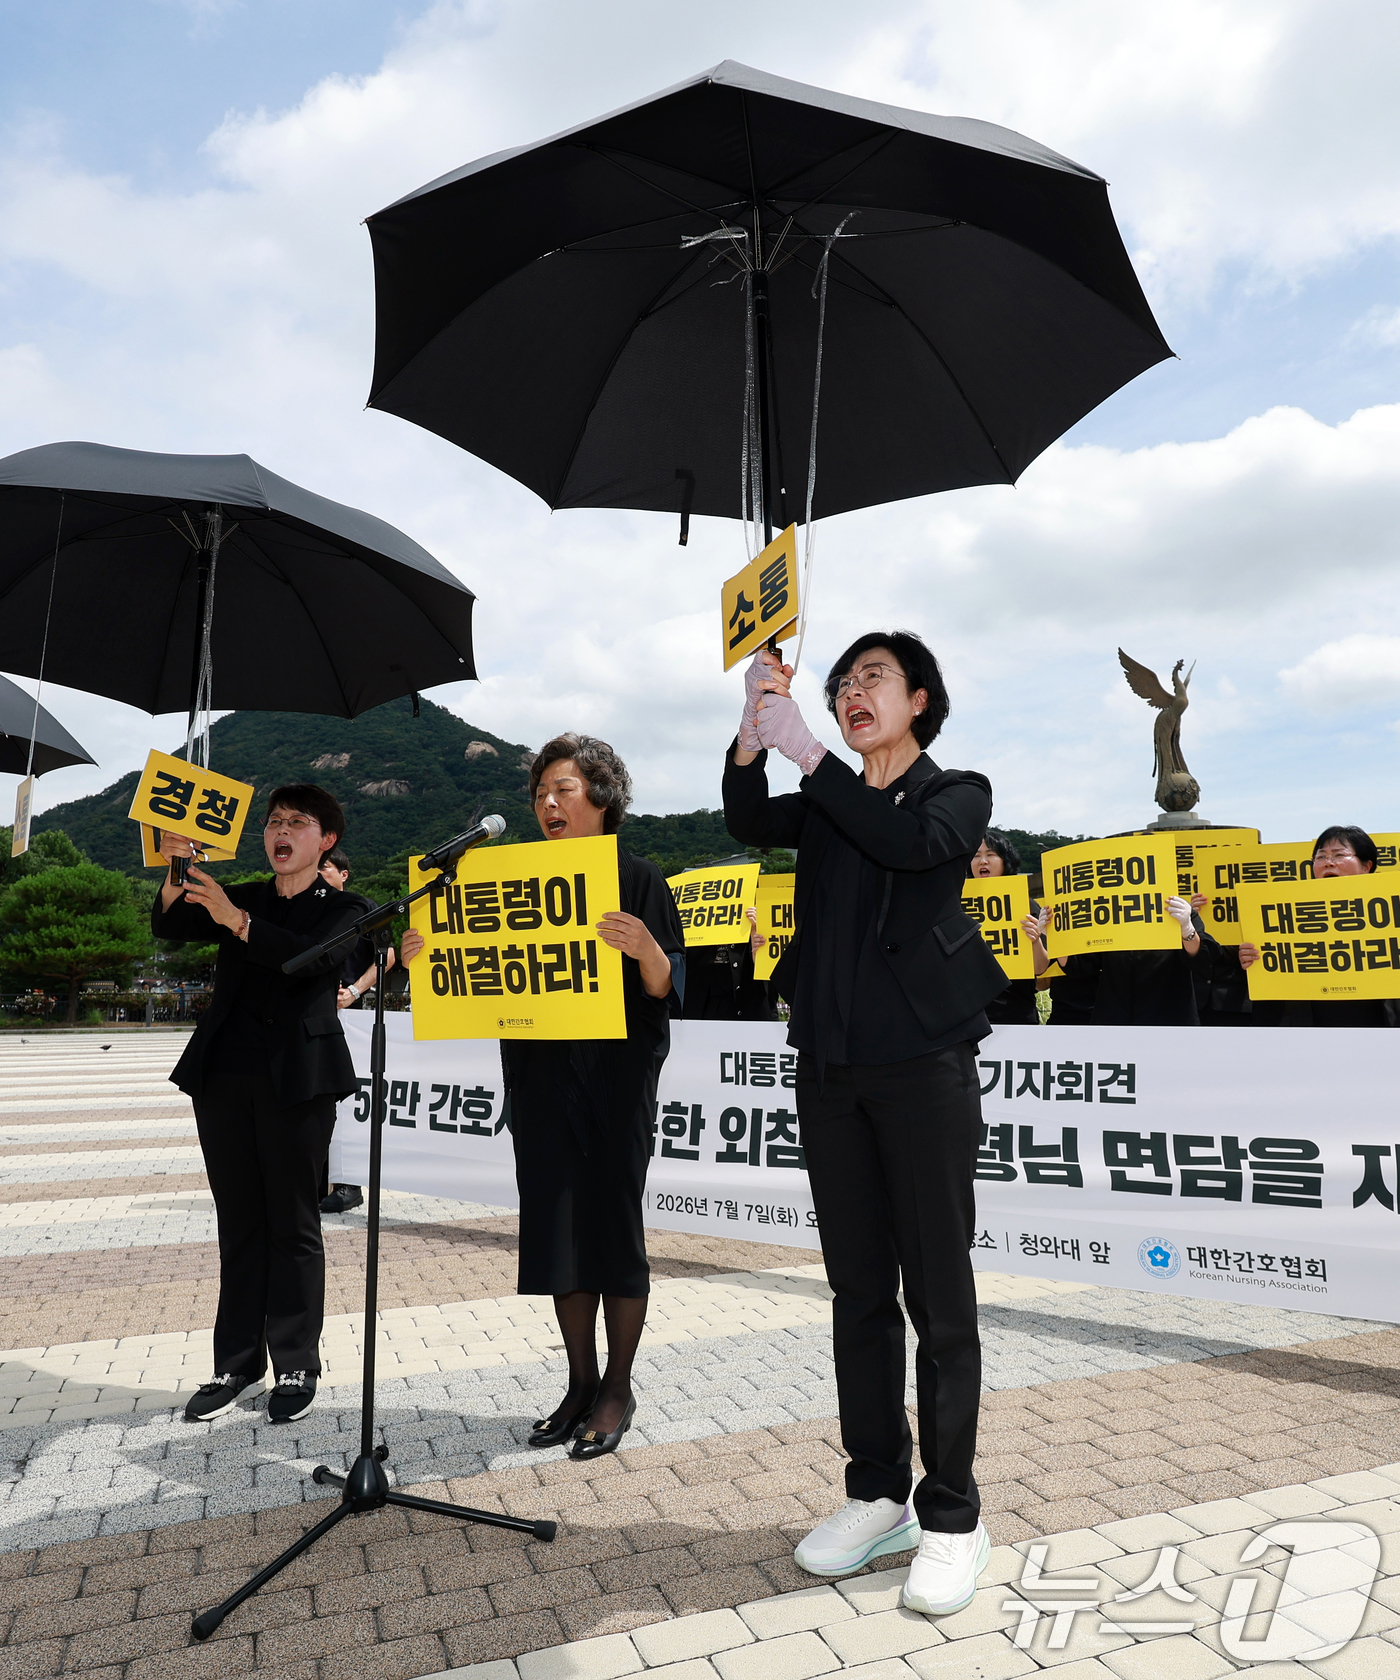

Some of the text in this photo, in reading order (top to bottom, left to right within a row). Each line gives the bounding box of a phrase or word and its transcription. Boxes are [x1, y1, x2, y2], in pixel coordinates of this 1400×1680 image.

[729, 552, 789, 651] 소통
[149, 770, 240, 836] 경청
[1054, 855, 1156, 895] 대통령이
[1376, 845, 1400, 866] 령
[429, 873, 588, 934] 대통령이
[1053, 893, 1163, 932] 해결하라!
[1261, 895, 1400, 934] 대통령이
[768, 935, 794, 960] 해
[429, 939, 599, 996] 해결하라!
[979, 1060, 1136, 1104] 기자회견
[651, 1101, 706, 1161] 한
[1103, 1130, 1324, 1209] 면담을
[656, 1193, 708, 1216] 2026년
[714, 1200, 739, 1220] 7월
[744, 1204, 799, 1227] 7일(화)
[1019, 1233, 1081, 1261] 청와대
[1089, 1241, 1111, 1264] 앞
[1186, 1246, 1328, 1282] 대한간호협회
[1189, 1270, 1328, 1294] Korean Nursing Association
